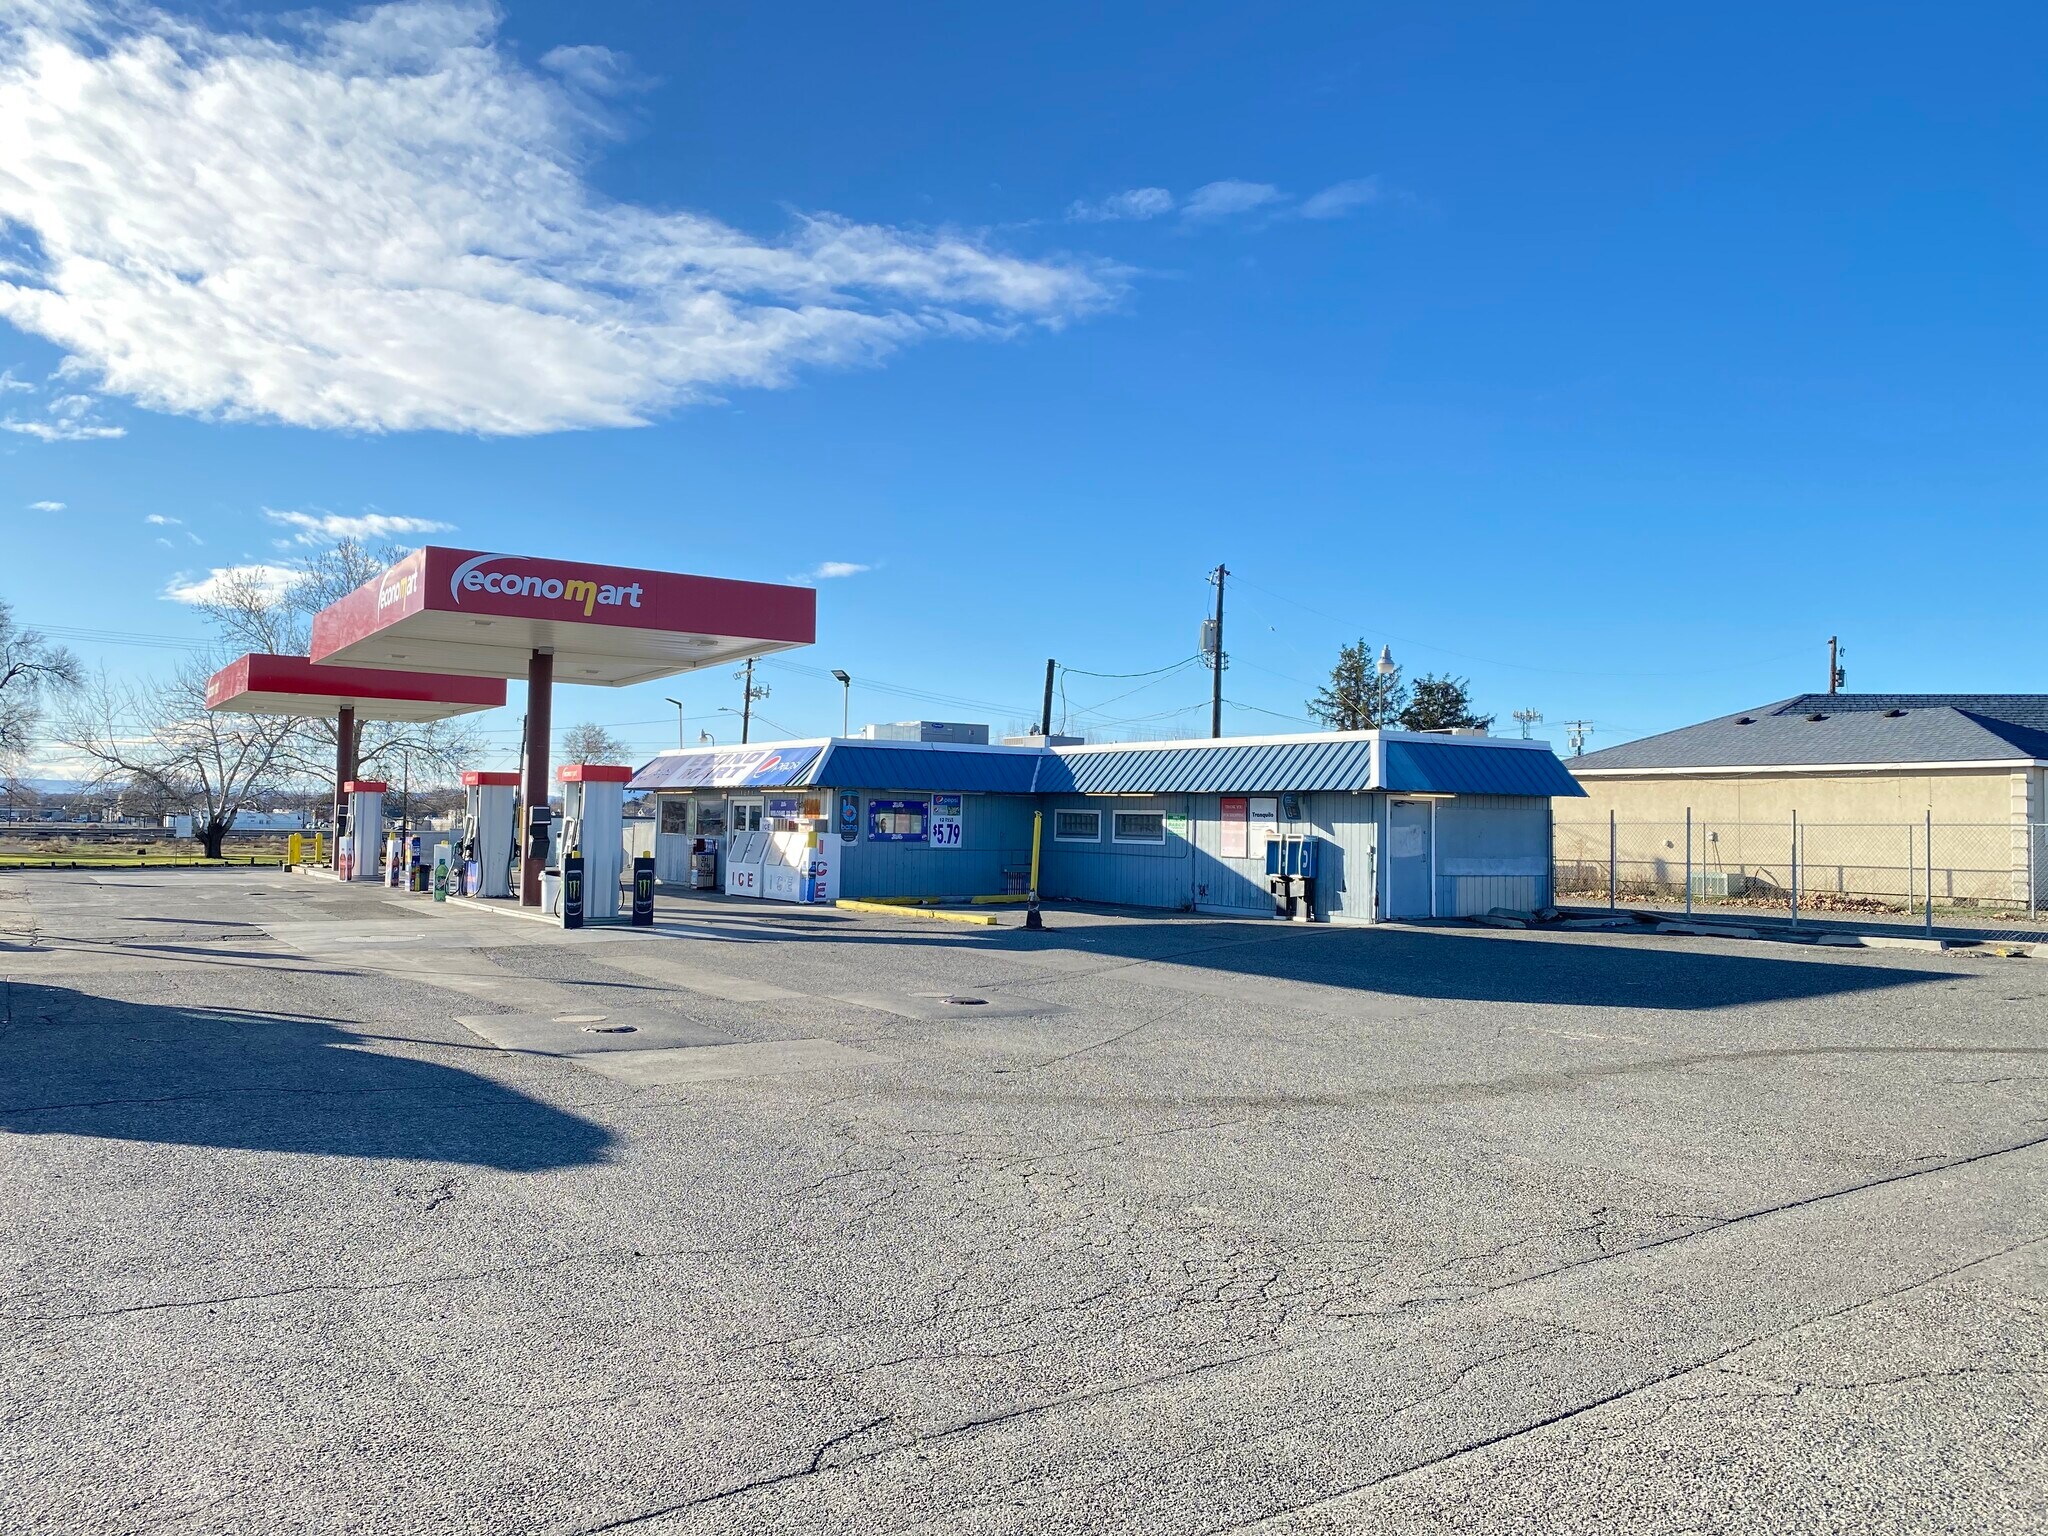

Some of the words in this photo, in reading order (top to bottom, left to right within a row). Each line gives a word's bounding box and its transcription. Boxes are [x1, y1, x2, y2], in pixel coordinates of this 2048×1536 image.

[462, 569, 644, 617] economart
[689, 752, 767, 766] ECONO
[679, 766, 747, 779] MART
[932, 823, 961, 844] $5.79
[732, 872, 754, 888] ICE
[769, 874, 793, 893] ICE
